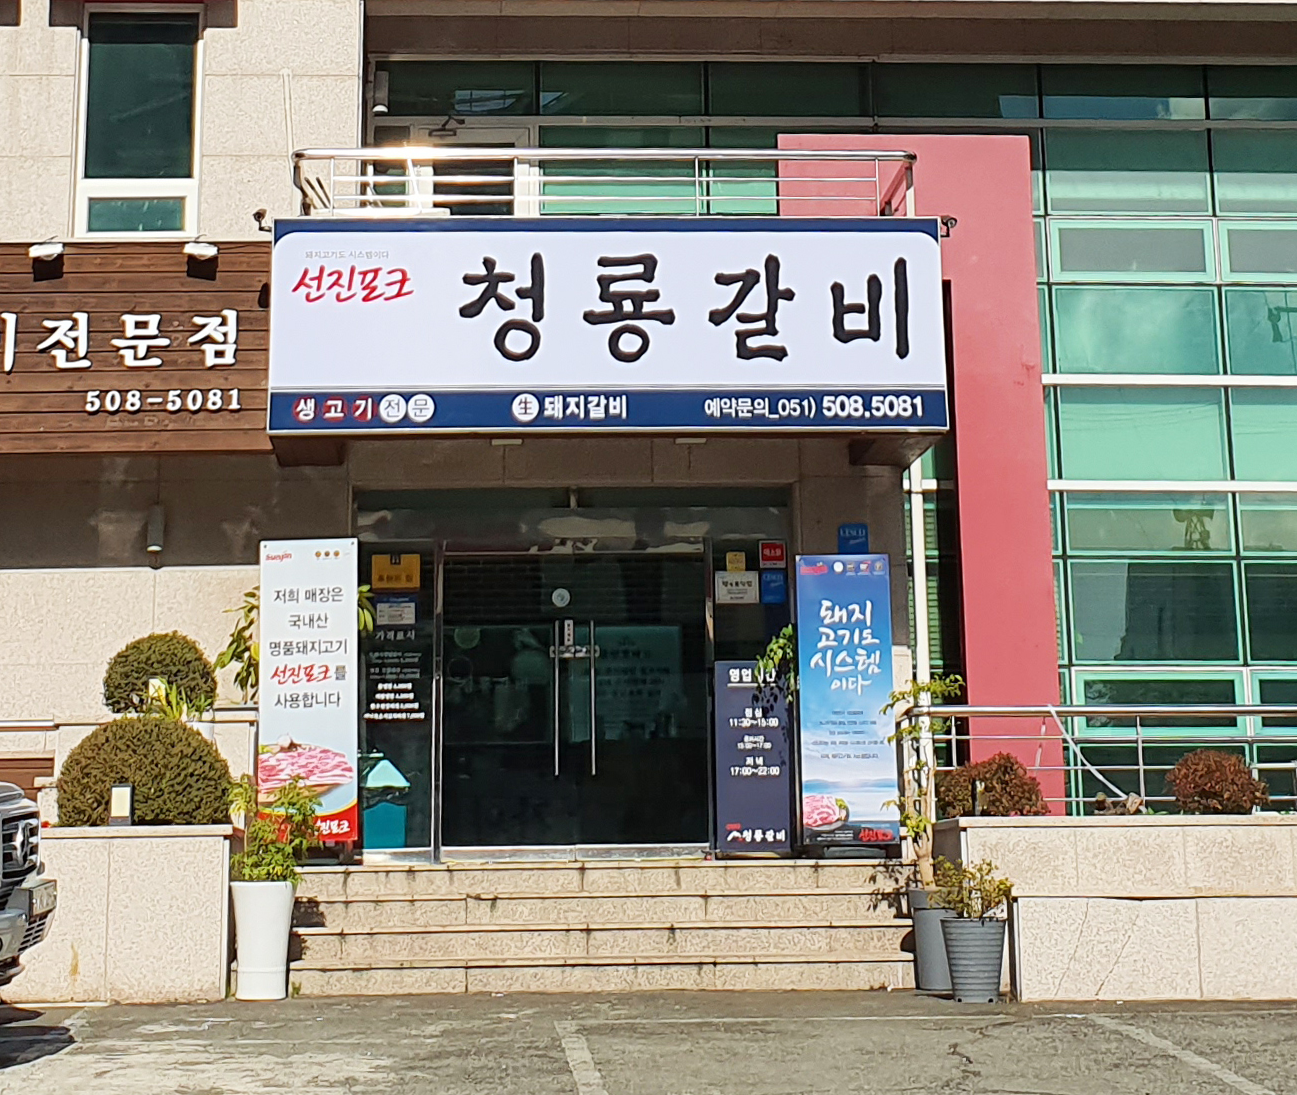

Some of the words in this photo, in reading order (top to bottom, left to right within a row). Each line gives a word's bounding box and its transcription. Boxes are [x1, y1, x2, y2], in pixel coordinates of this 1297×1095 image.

[292, 264, 414, 302] 선진포크
[459, 252, 909, 363] 청룡갈비
[85, 389, 242, 414] 508-5081
[822, 395, 923, 418] 508.5081
[274, 587, 300, 604] 저희
[304, 586, 344, 603] 매장은
[288, 612, 329, 630] 국내산
[819, 599, 872, 626] 돼지
[269, 638, 347, 657] 명품돼지고기
[817, 627, 880, 649] 고기도
[810, 647, 882, 678] 시스템
[830, 673, 873, 696] 이다
[274, 691, 341, 709] 사용합니다
